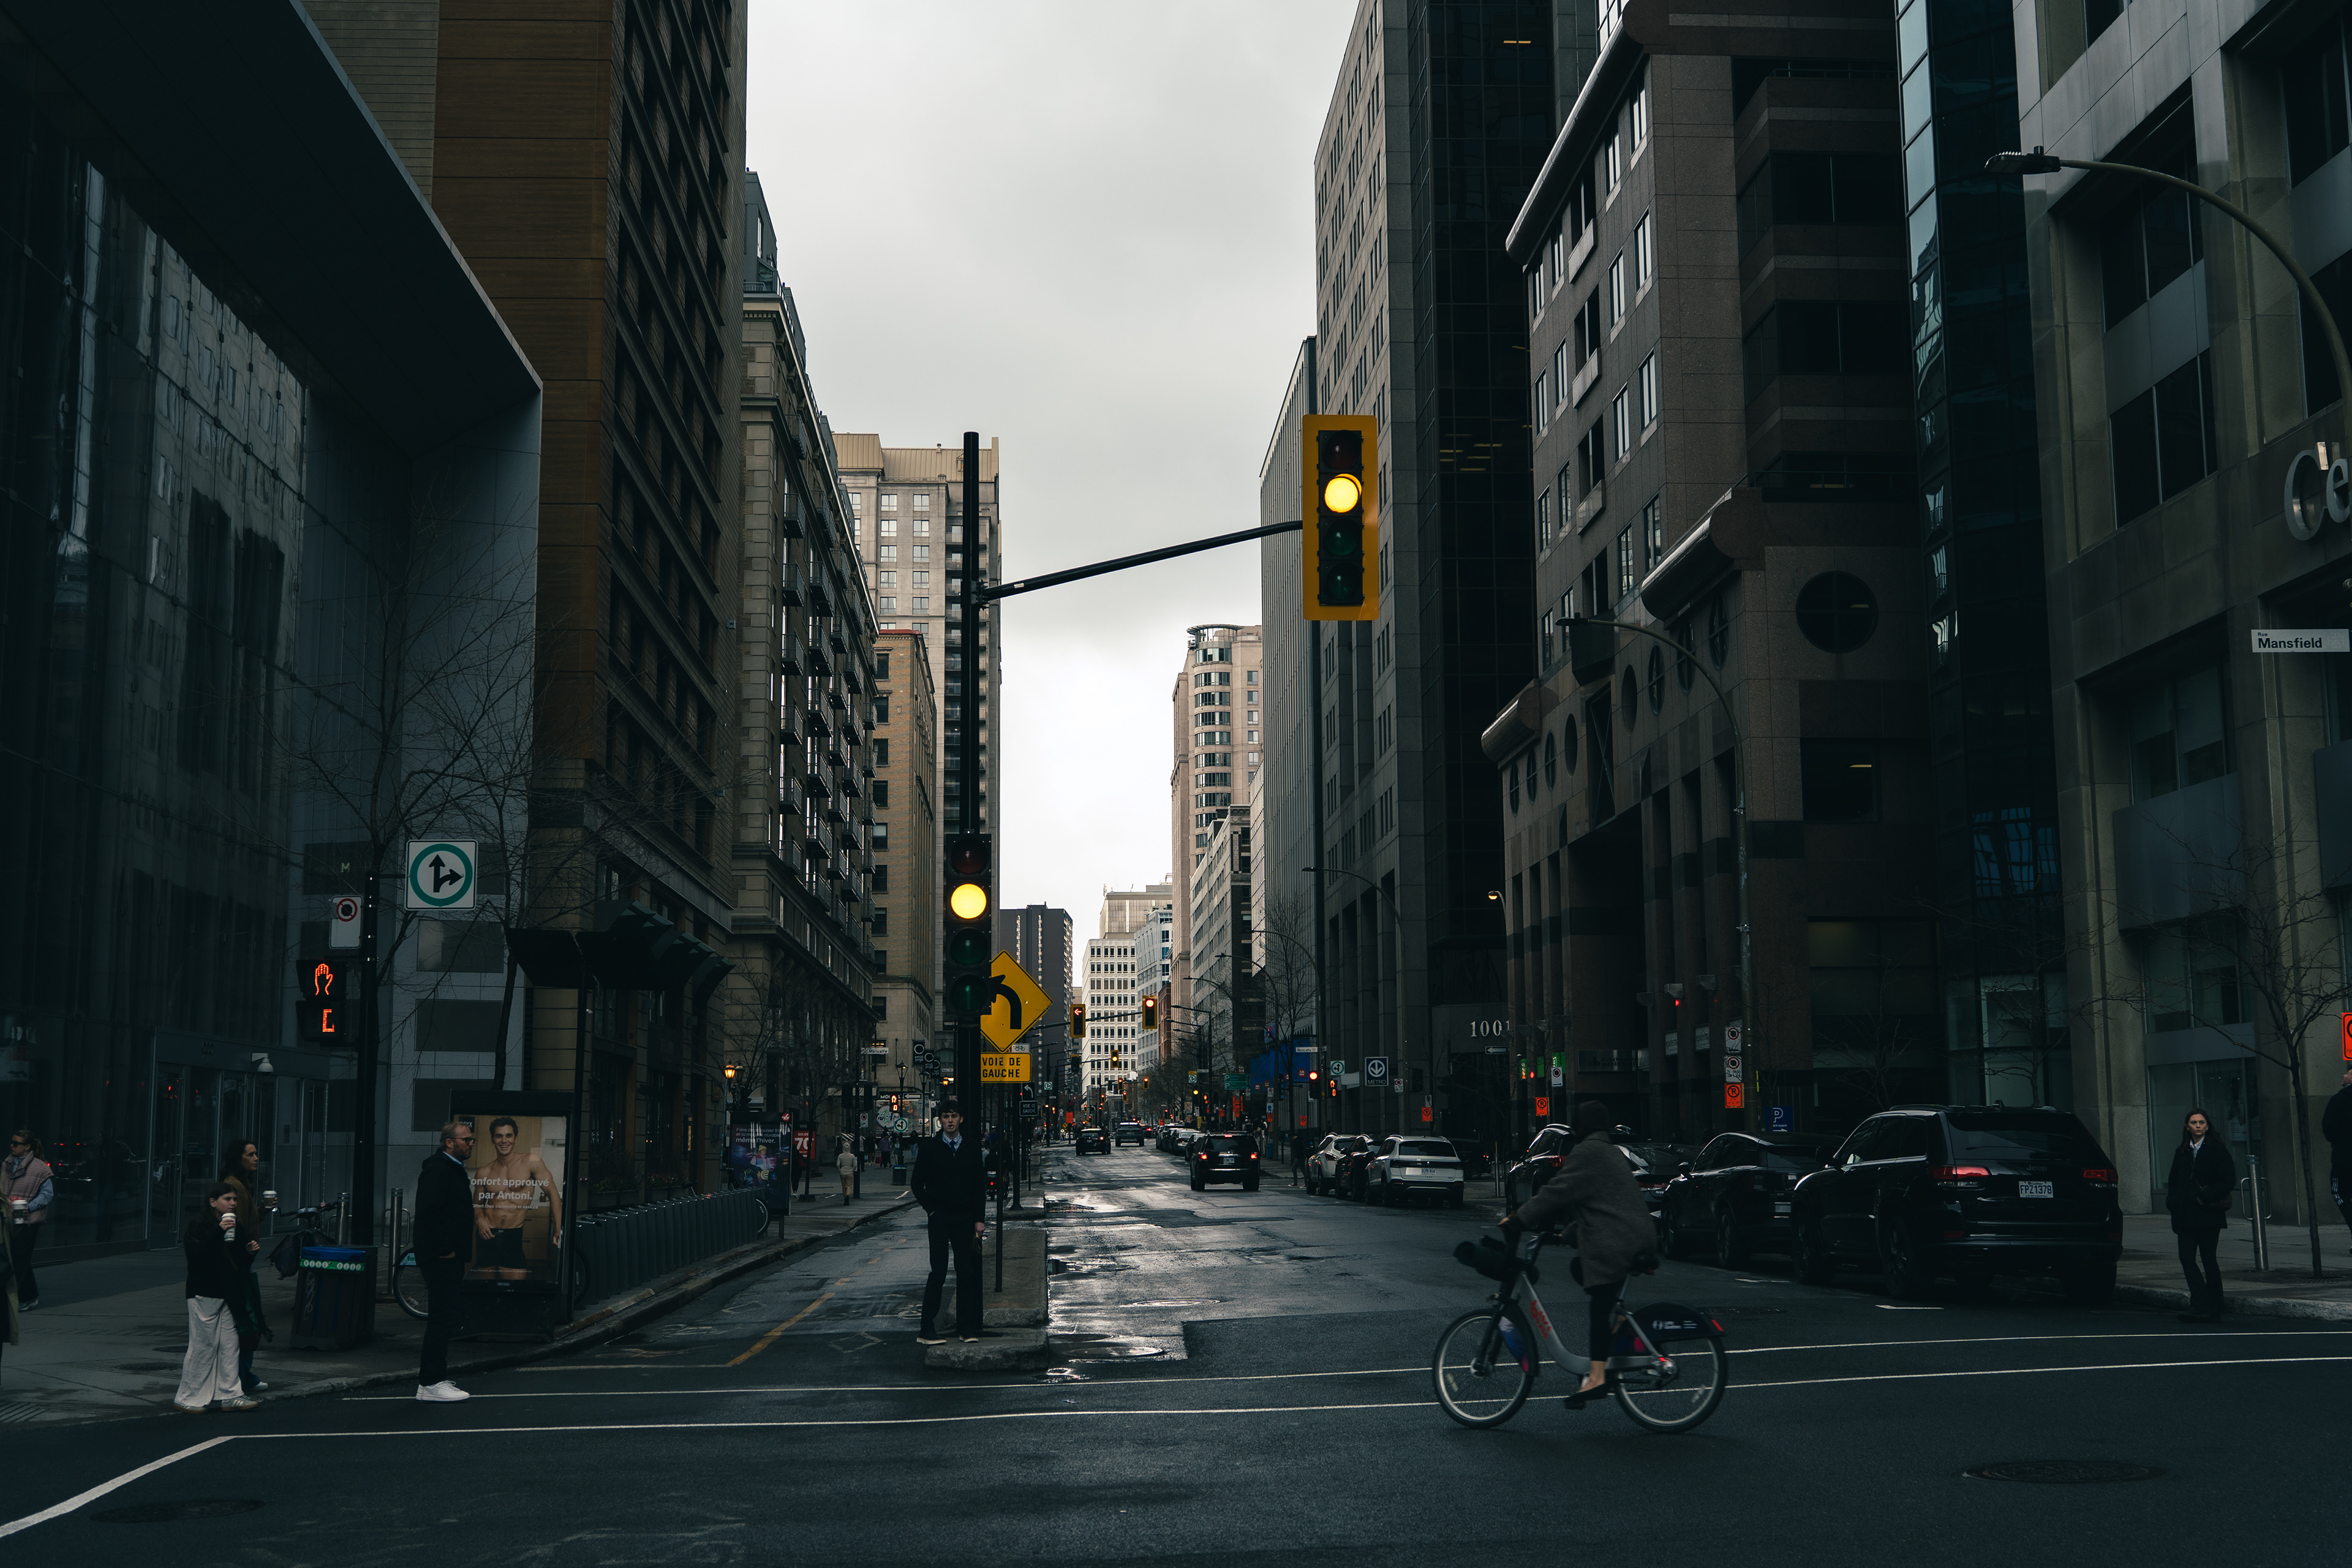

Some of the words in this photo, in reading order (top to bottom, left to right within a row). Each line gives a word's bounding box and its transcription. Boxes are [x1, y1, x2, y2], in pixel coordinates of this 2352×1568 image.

[2258, 638, 2323, 649] Mansfield
[982, 1057, 1003, 1066] VOIE
[1009, 1057, 1020, 1066] DE
[982, 1069, 1020, 1077] GAUCHE
[469, 1177, 500, 1186] onfort
[502, 1178, 549, 1188] approuvé
[2020, 1185, 2052, 1194] FPZ1378
[478, 1191, 495, 1200] par
[497, 1191, 532, 1200] Antoni.
